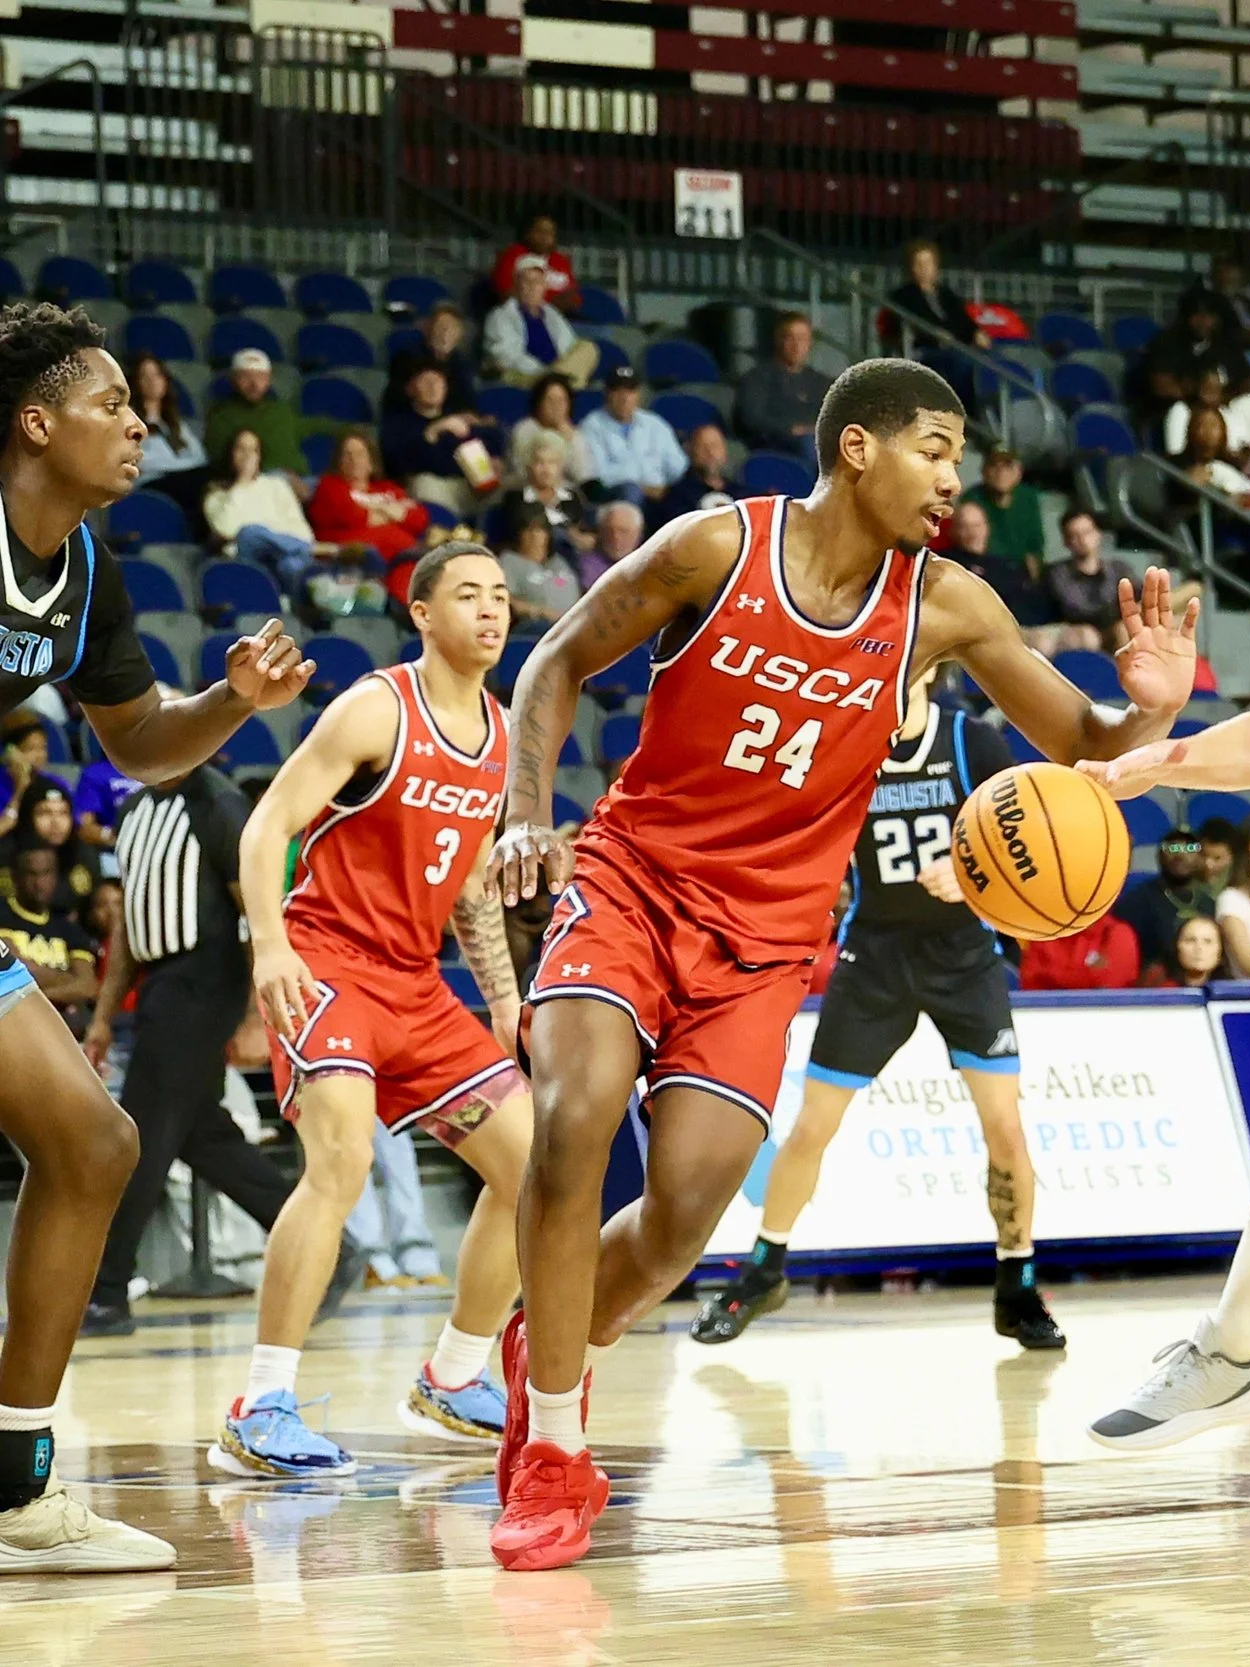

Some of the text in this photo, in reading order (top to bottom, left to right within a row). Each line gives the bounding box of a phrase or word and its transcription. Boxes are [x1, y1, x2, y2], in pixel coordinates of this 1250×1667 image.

[709, 635, 884, 711] USCA
[722, 703, 823, 789] 24
[400, 775, 501, 820] USCA
[868, 778, 957, 813] UGUSTA
[424, 826, 461, 886] 3
[872, 813, 951, 884] 22
[955, 817, 992, 894] NCAA
[990, 775, 1039, 883] Wilson
[866, 1063, 1155, 1115] Augu-Aiken
[867, 1118, 1177, 1159] ORTHPEDIC
[895, 1164, 1173, 1198] SPELISTS
